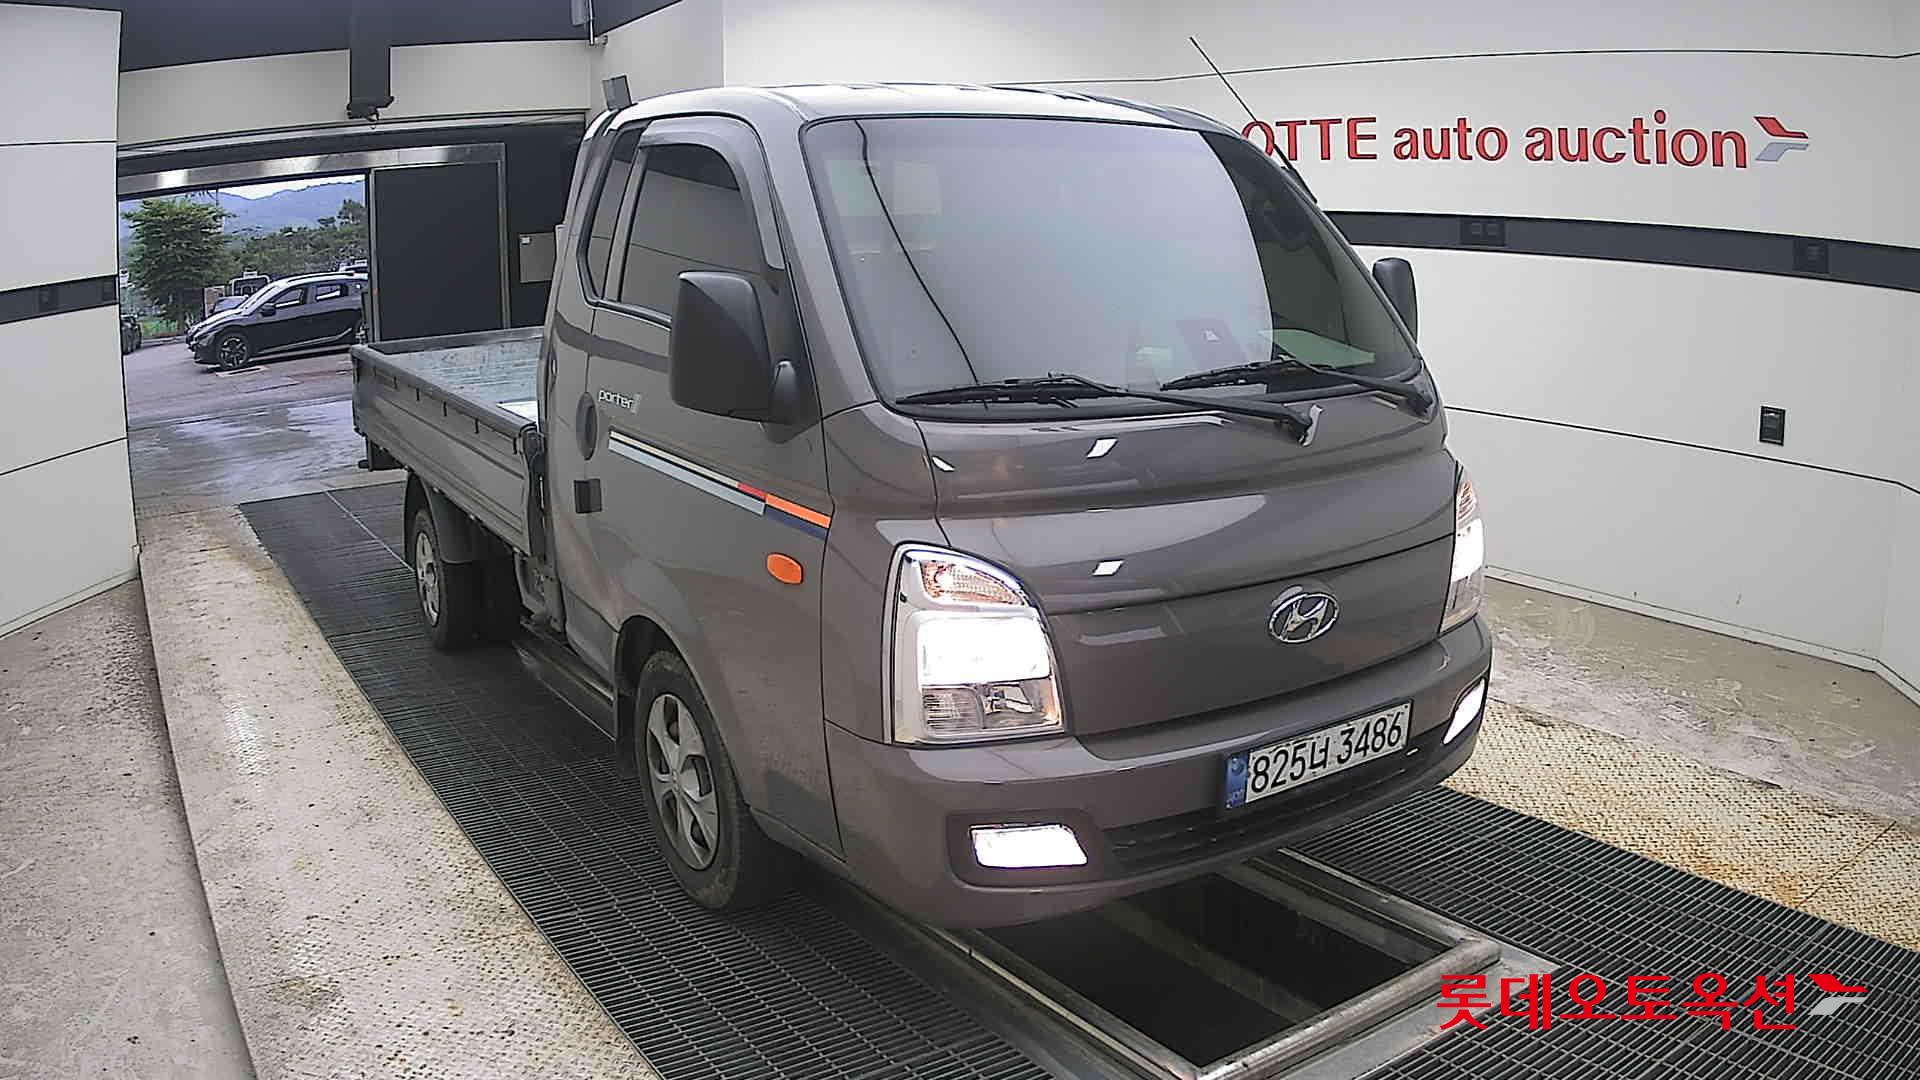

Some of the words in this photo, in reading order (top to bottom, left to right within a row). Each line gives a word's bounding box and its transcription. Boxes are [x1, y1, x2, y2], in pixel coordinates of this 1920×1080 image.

[1241, 116, 1377, 161] OTTE
[1393, 117, 1509, 161] auto
[1525, 109, 1748, 168] auction
[1251, 736, 1330, 792] 825너
[1337, 711, 1401, 763] 3486
